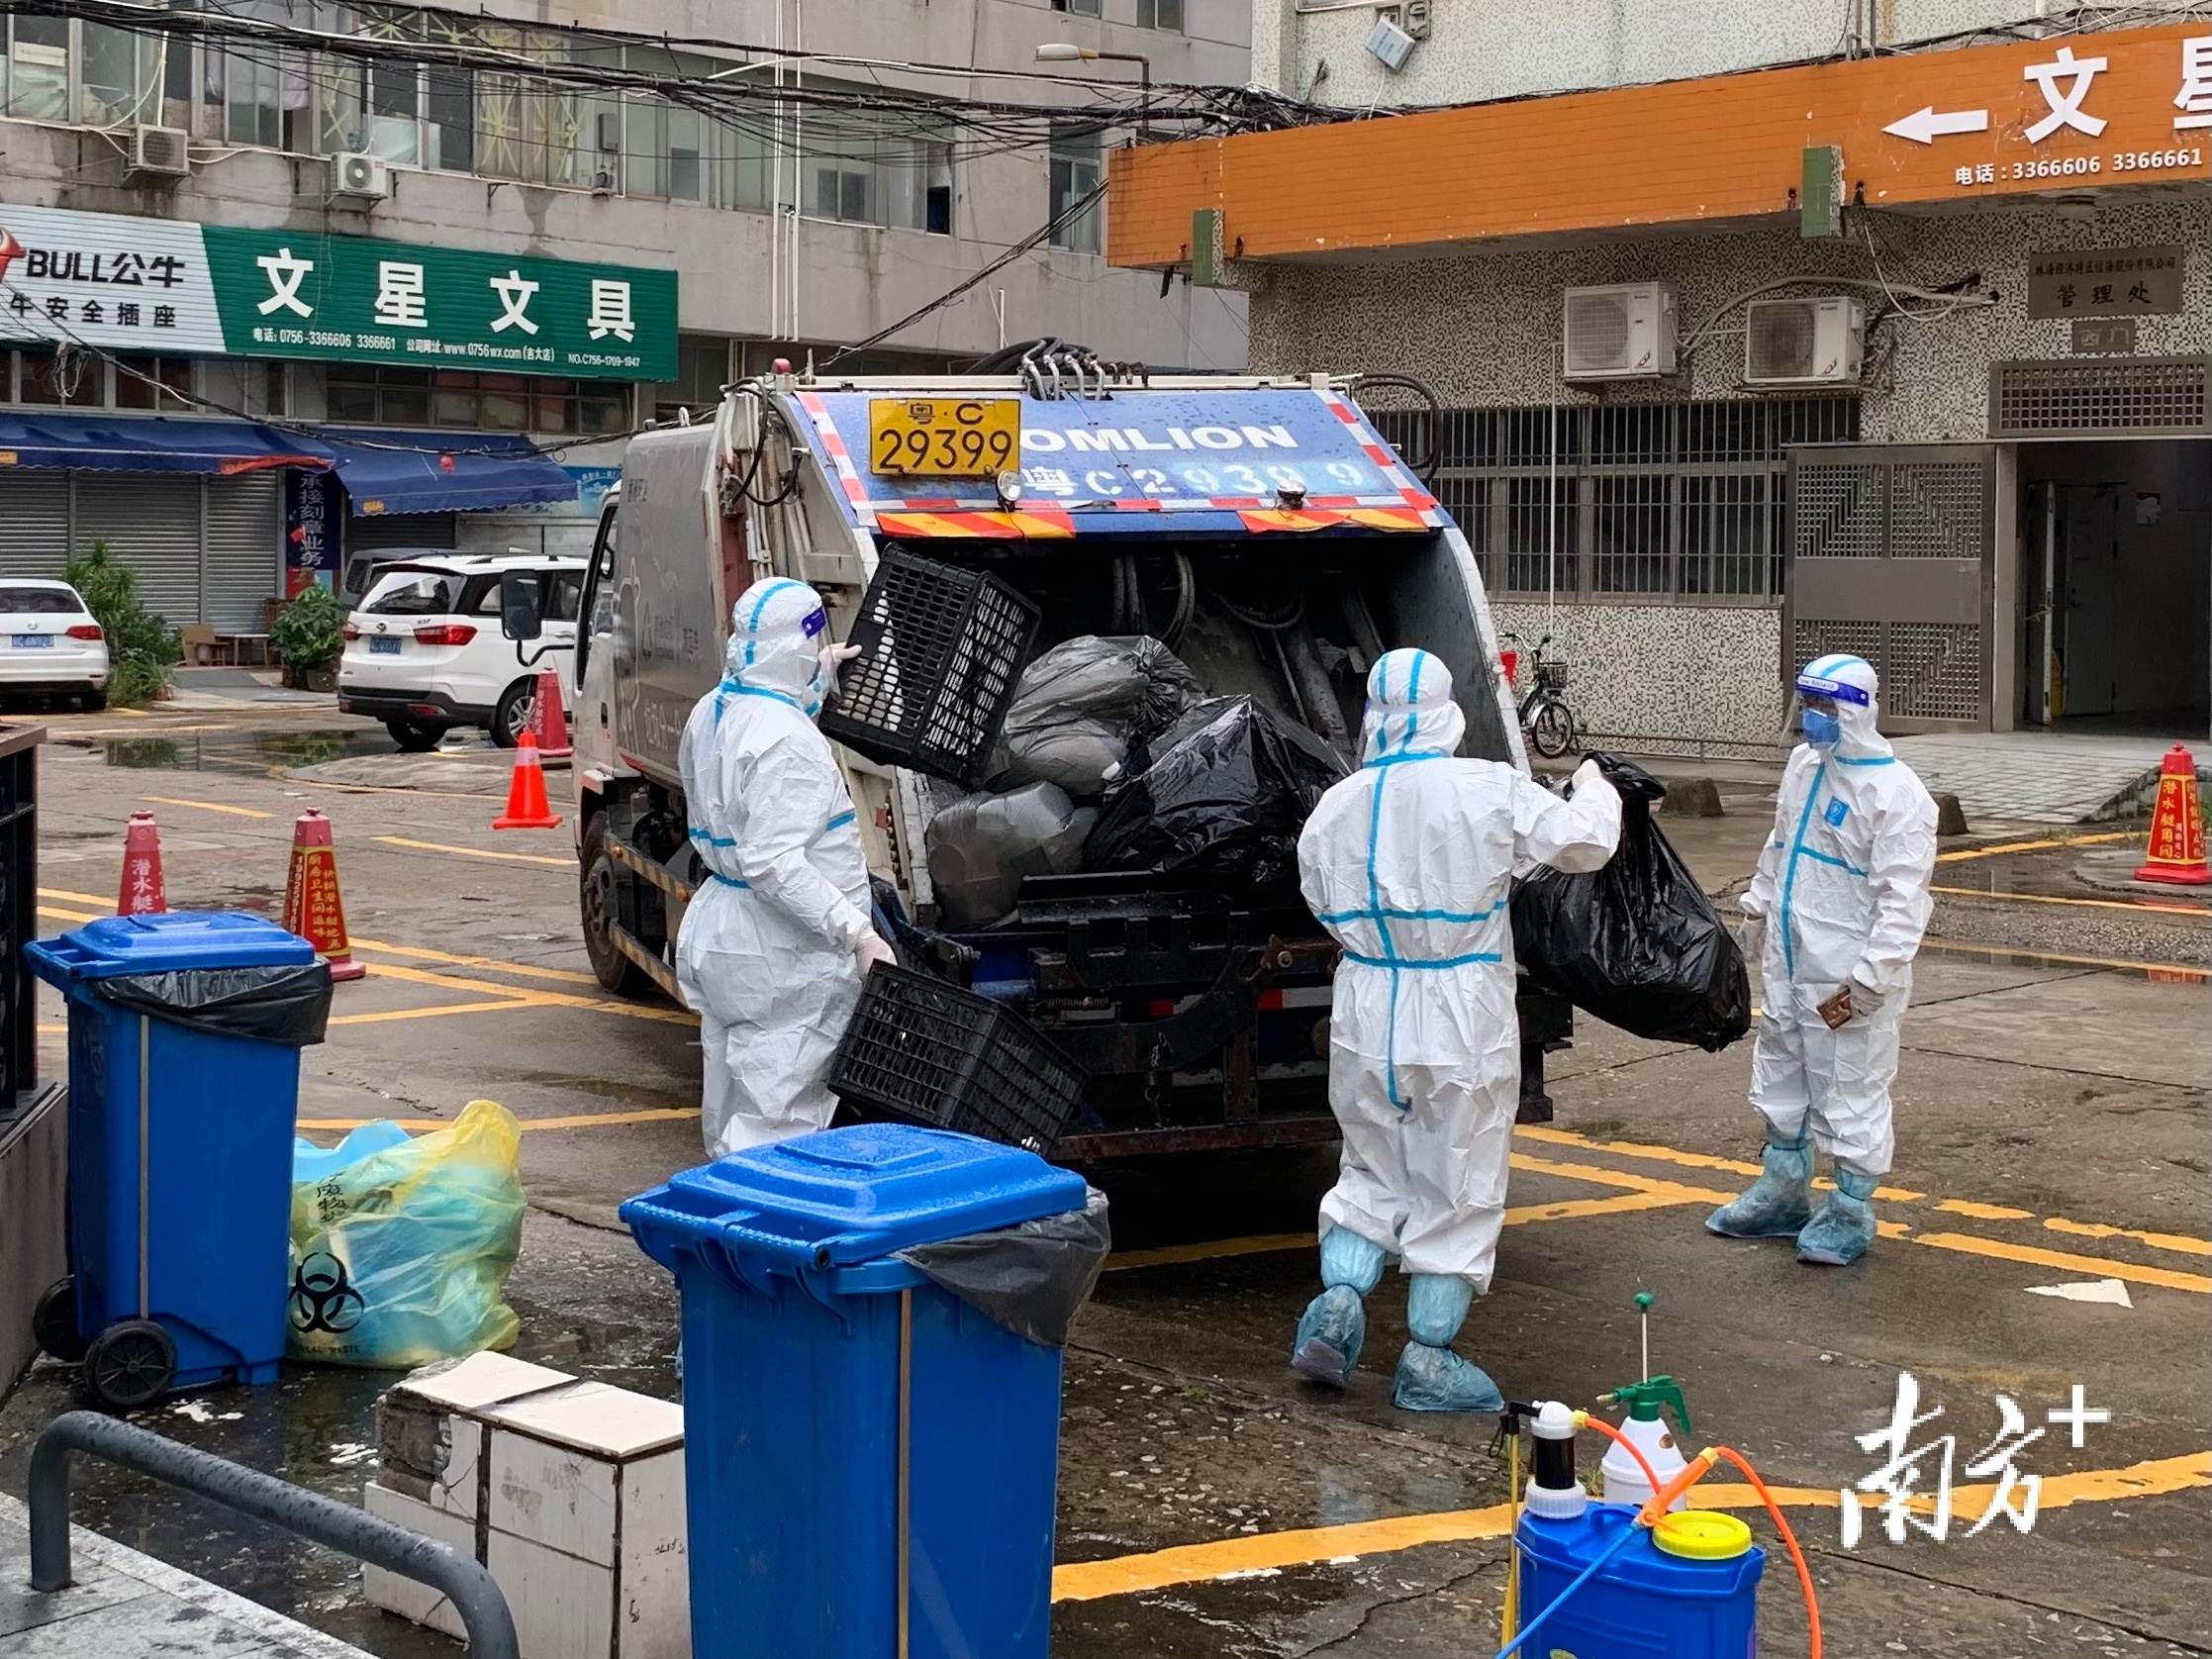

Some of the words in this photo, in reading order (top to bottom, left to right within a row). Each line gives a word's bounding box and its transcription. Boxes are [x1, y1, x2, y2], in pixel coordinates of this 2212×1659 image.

[2112, 148, 2202, 172] 3366661
[27, 248, 185, 288] BULL公牛
[256, 247, 635, 343] 文星文具
[2057, 280, 2152, 308] 管理处
[356, 334, 396, 350] 3366661
[879, 429, 1012, 469] 29399
[300, 474, 325, 566] 承接刻章业务
[131, 858, 153, 915] 潜水艇
